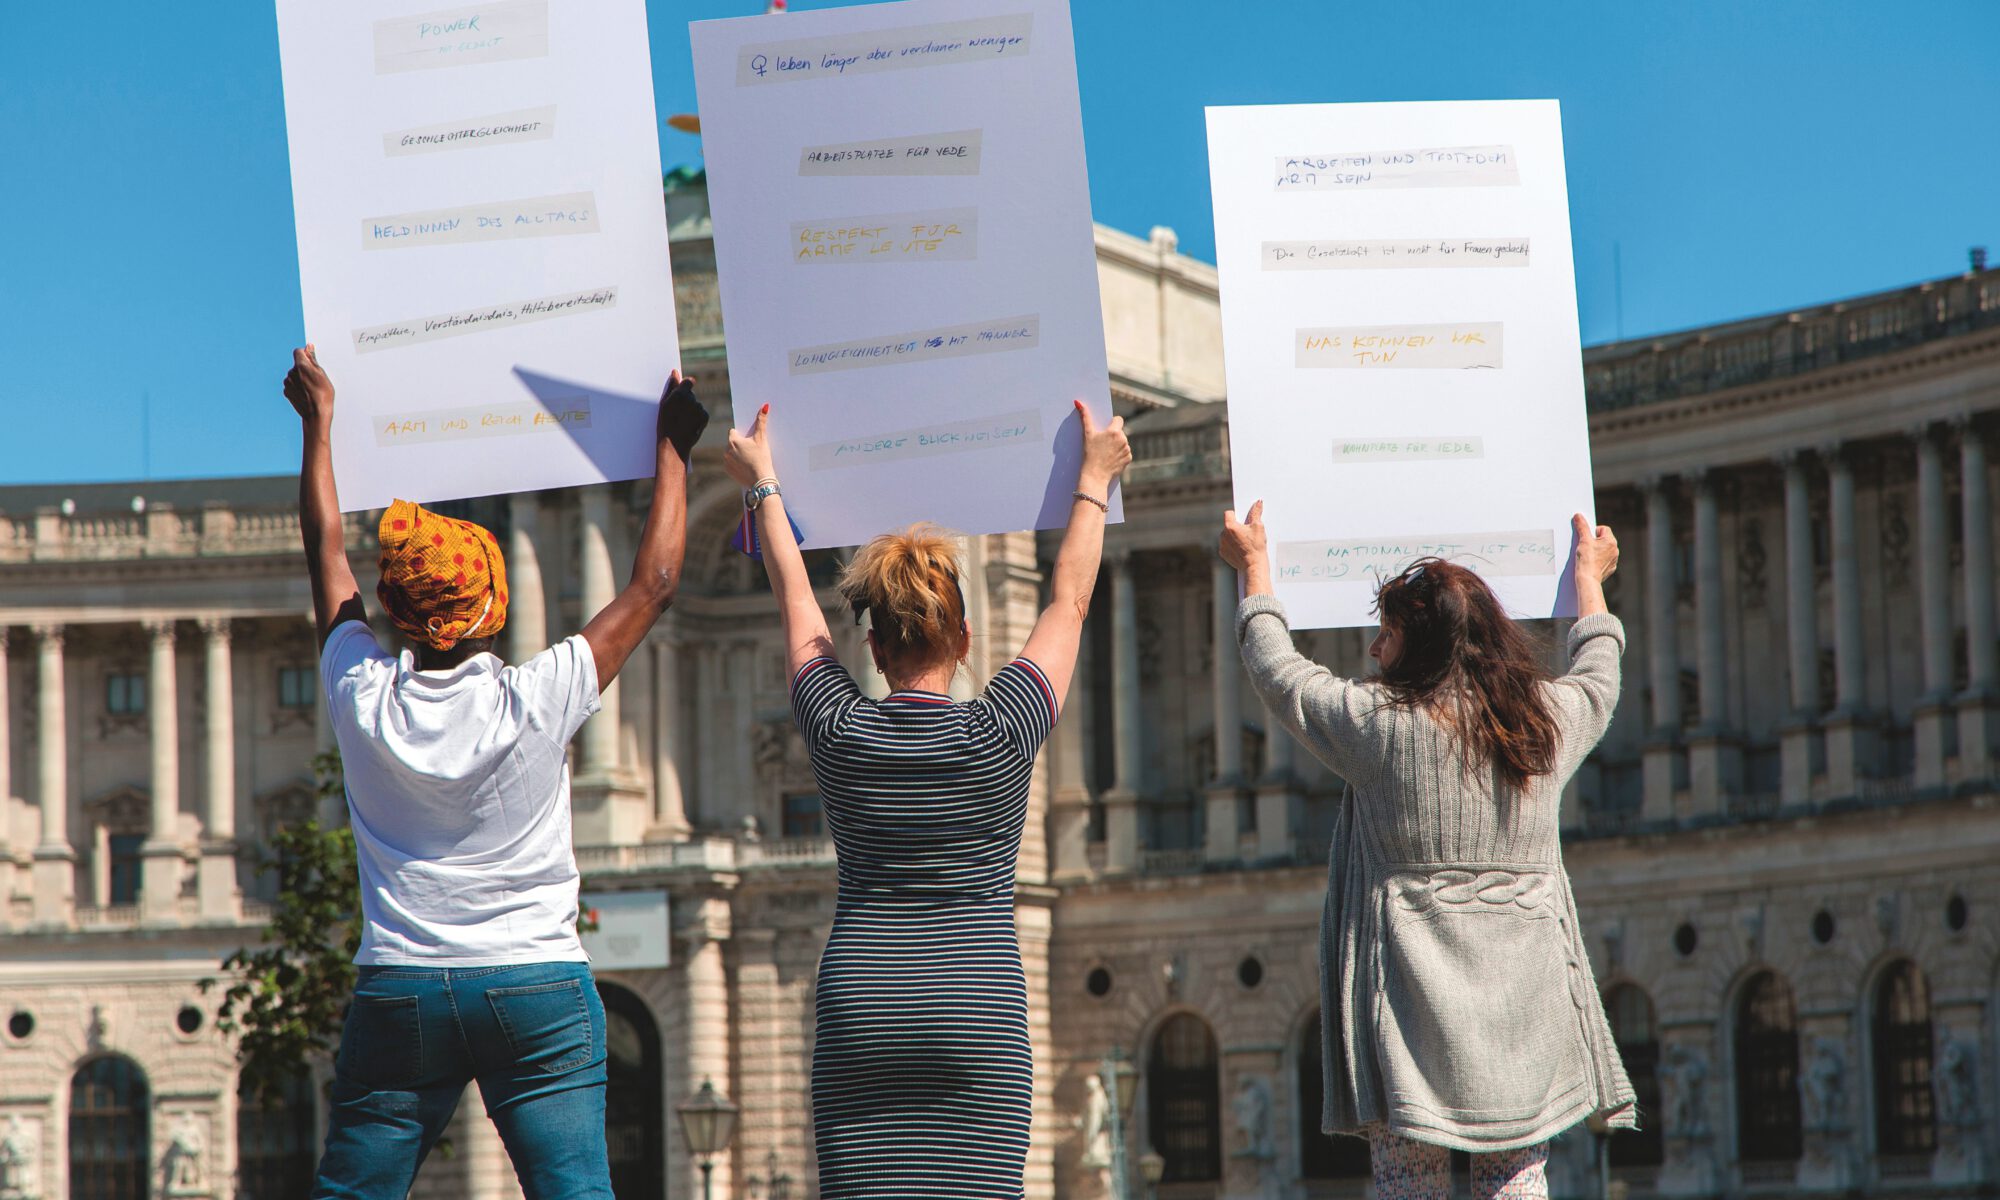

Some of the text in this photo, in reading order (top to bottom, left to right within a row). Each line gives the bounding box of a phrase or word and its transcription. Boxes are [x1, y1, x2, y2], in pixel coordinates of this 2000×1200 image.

[418, 15, 481, 39] POWER
[776, 55, 811, 71] leben
[821, 52, 861, 73] länger
[866, 48, 894, 60] aber
[968, 36, 1024, 53] weniger
[906, 146, 929, 158] FÜR
[1286, 156, 1372, 169] ARBEITEN
[1383, 154, 1415, 164] UND
[1277, 172, 1372, 187] ARM SEIN
[374, 210, 590, 240] HELDINNEN DES ALLTAGS
[800, 226, 889, 243] RESPEKT
[799, 243, 857, 259] ARME
[1272, 247, 1295, 261] Die
[1438, 242, 1456, 254] für
[1464, 241, 1492, 254] Frauen
[1353, 350, 1397, 366] TUN
[384, 420, 426, 435] ARM
[441, 418, 469, 431] UND
[835, 437, 909, 456] ANDERE
[1480, 543, 1509, 554] IST
